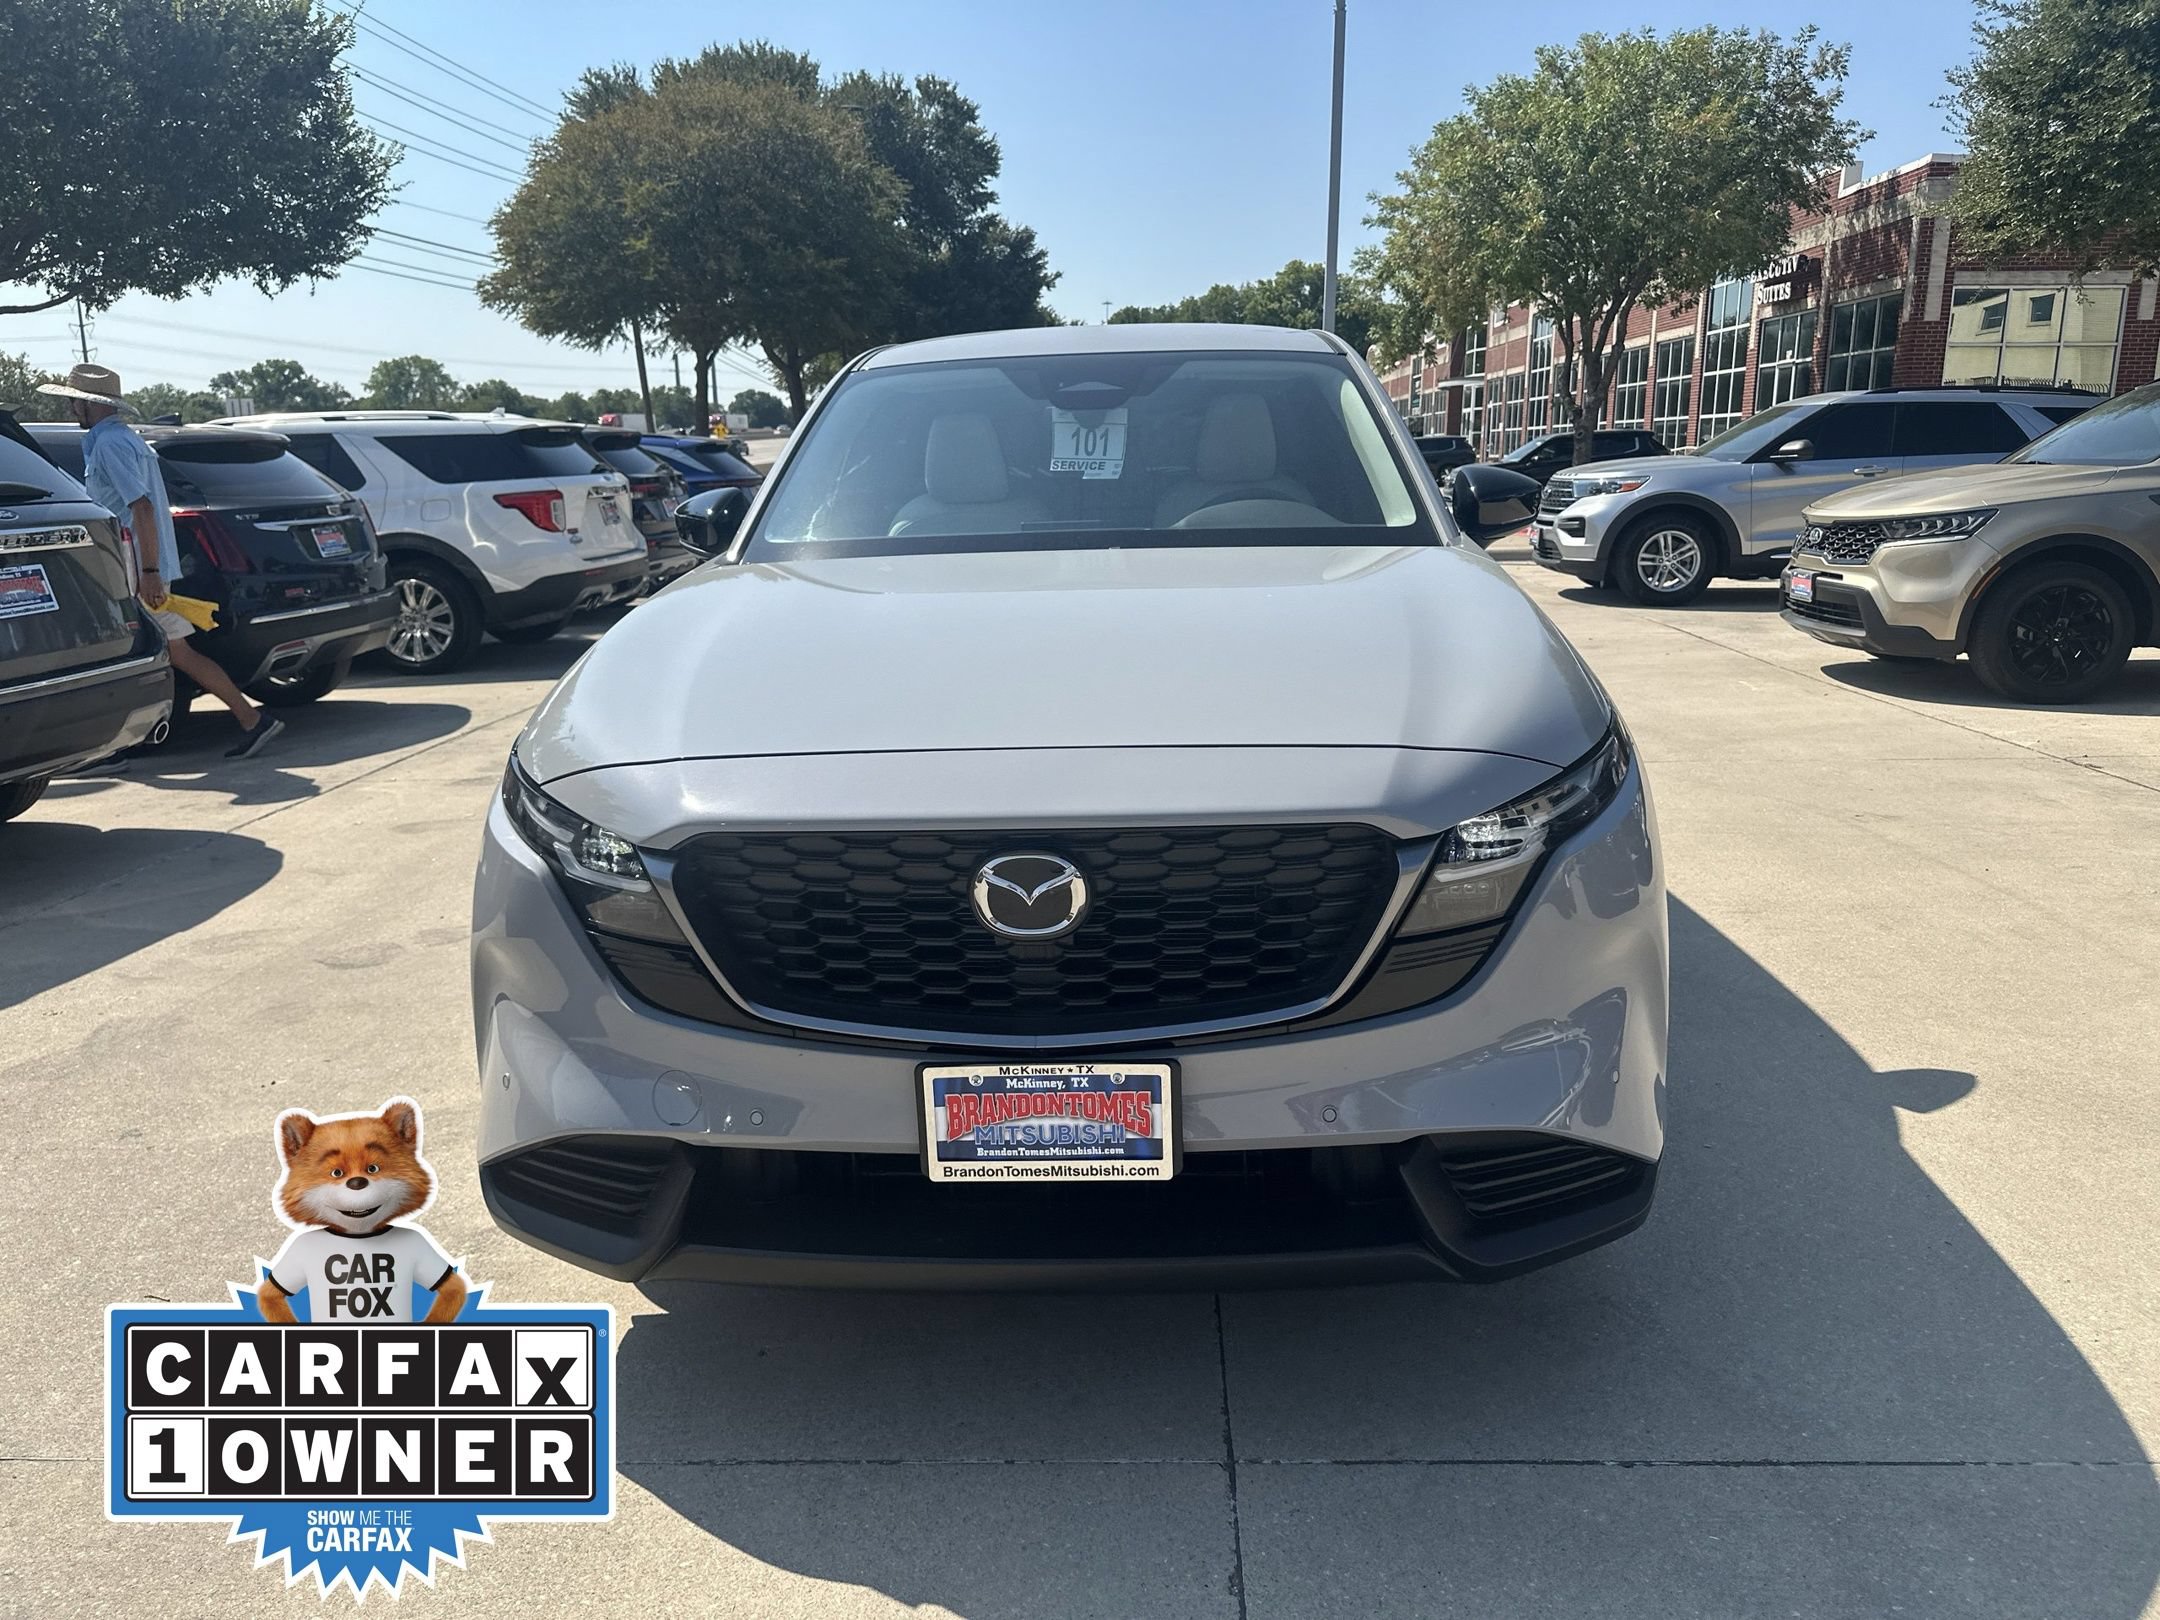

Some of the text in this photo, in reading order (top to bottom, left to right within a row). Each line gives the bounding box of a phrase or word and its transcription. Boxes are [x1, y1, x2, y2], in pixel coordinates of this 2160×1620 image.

[1757, 281, 1791, 304] SUITES
[1071, 427, 1109, 457] 101
[1052, 460, 1107, 471] SERVICE
[1076, 1065, 1095, 1075] TX
[1006, 1077, 1089, 1090] McKinney, TX
[974, 1124, 1126, 1146] MITSUBISHI
[976, 1146, 1125, 1158] BrandonTomesMitsubishi.com
[943, 1165, 1160, 1178] BrandonTomesMitsubishi.com
